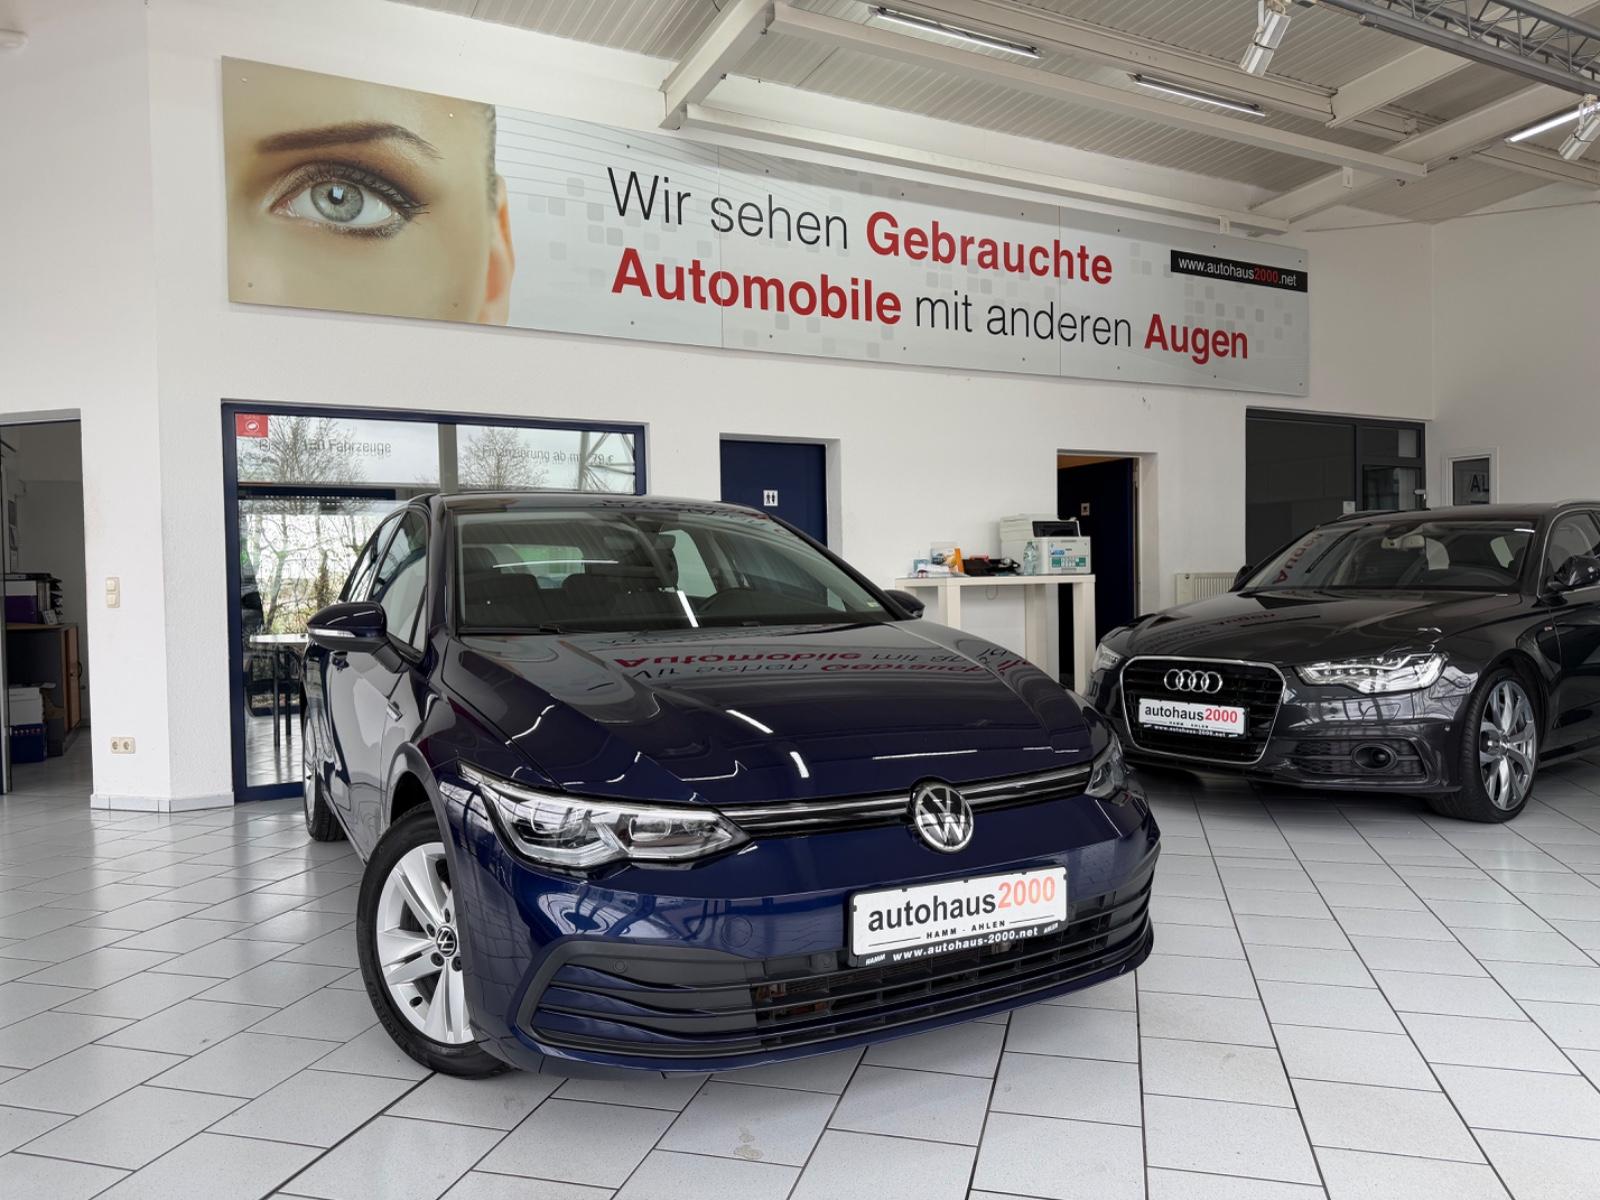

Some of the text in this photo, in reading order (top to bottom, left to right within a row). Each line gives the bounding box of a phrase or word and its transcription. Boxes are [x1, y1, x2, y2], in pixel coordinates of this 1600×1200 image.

[607, 166, 1113, 284] Wir sehen Gebrauchte
[1178, 257, 1297, 286] www.autohaus2000.net
[611, 247, 1248, 365] Automobile mit anderen Augen
[1144, 705, 1238, 724] autohaus2000
[867, 876, 1057, 932] autohaus2000
[893, 926, 1039, 962] www.autohaus-2000.net
[926, 928, 957, 939] HAMM
[971, 920, 1006, 932] AHLEN
